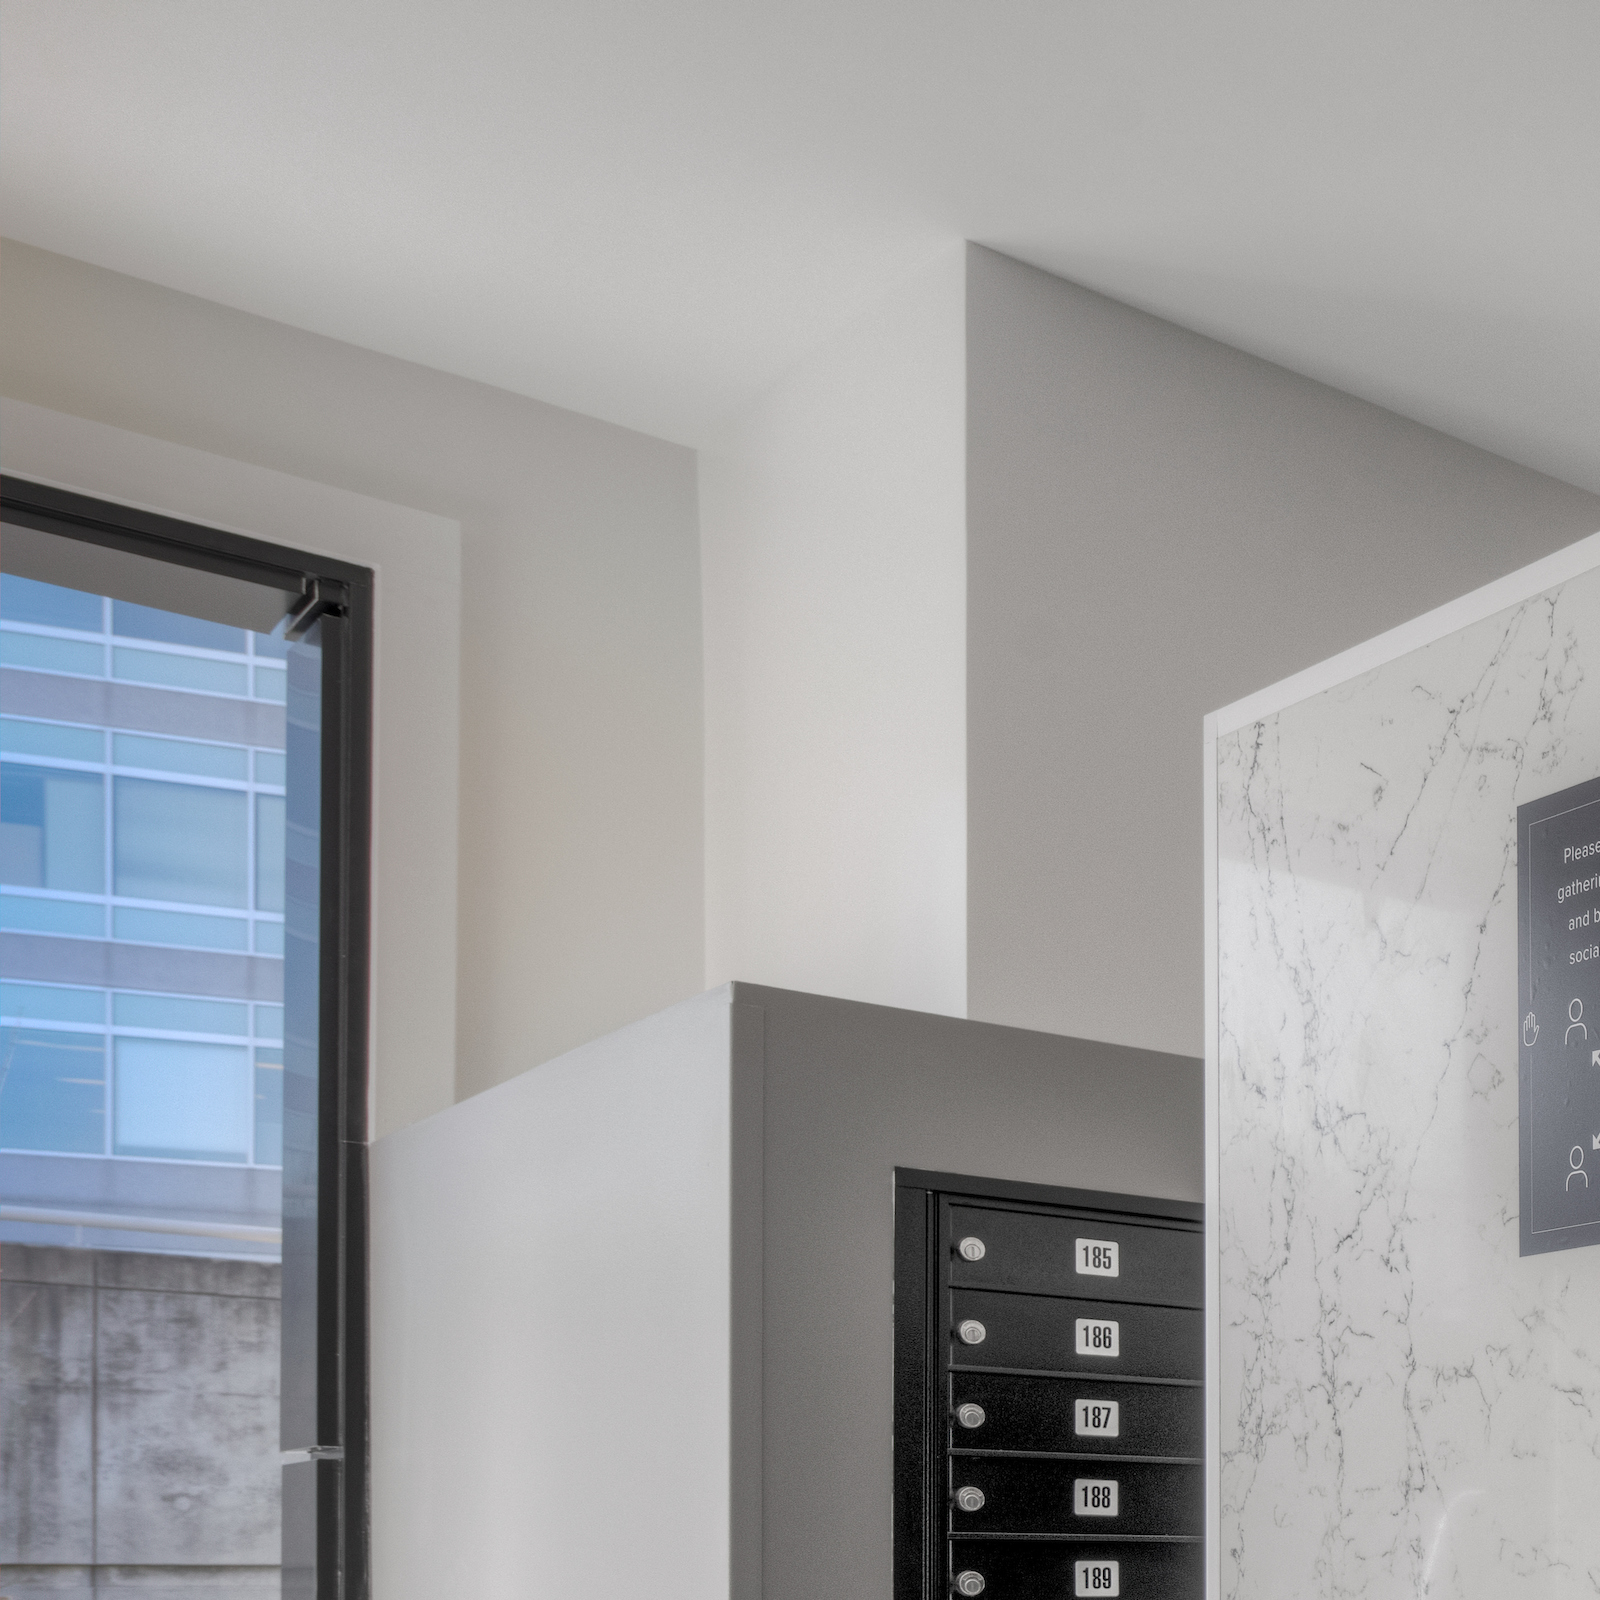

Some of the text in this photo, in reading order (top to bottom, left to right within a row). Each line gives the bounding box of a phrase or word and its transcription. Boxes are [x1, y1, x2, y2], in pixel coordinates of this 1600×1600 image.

[1568, 910, 1590, 931] and
[1082, 1245, 1112, 1270] 185
[1082, 1325, 1112, 1350] 186
[1082, 1405, 1112, 1429] 187
[1081, 1485, 1111, 1509] 188
[1081, 1567, 1112, 1590] 189
